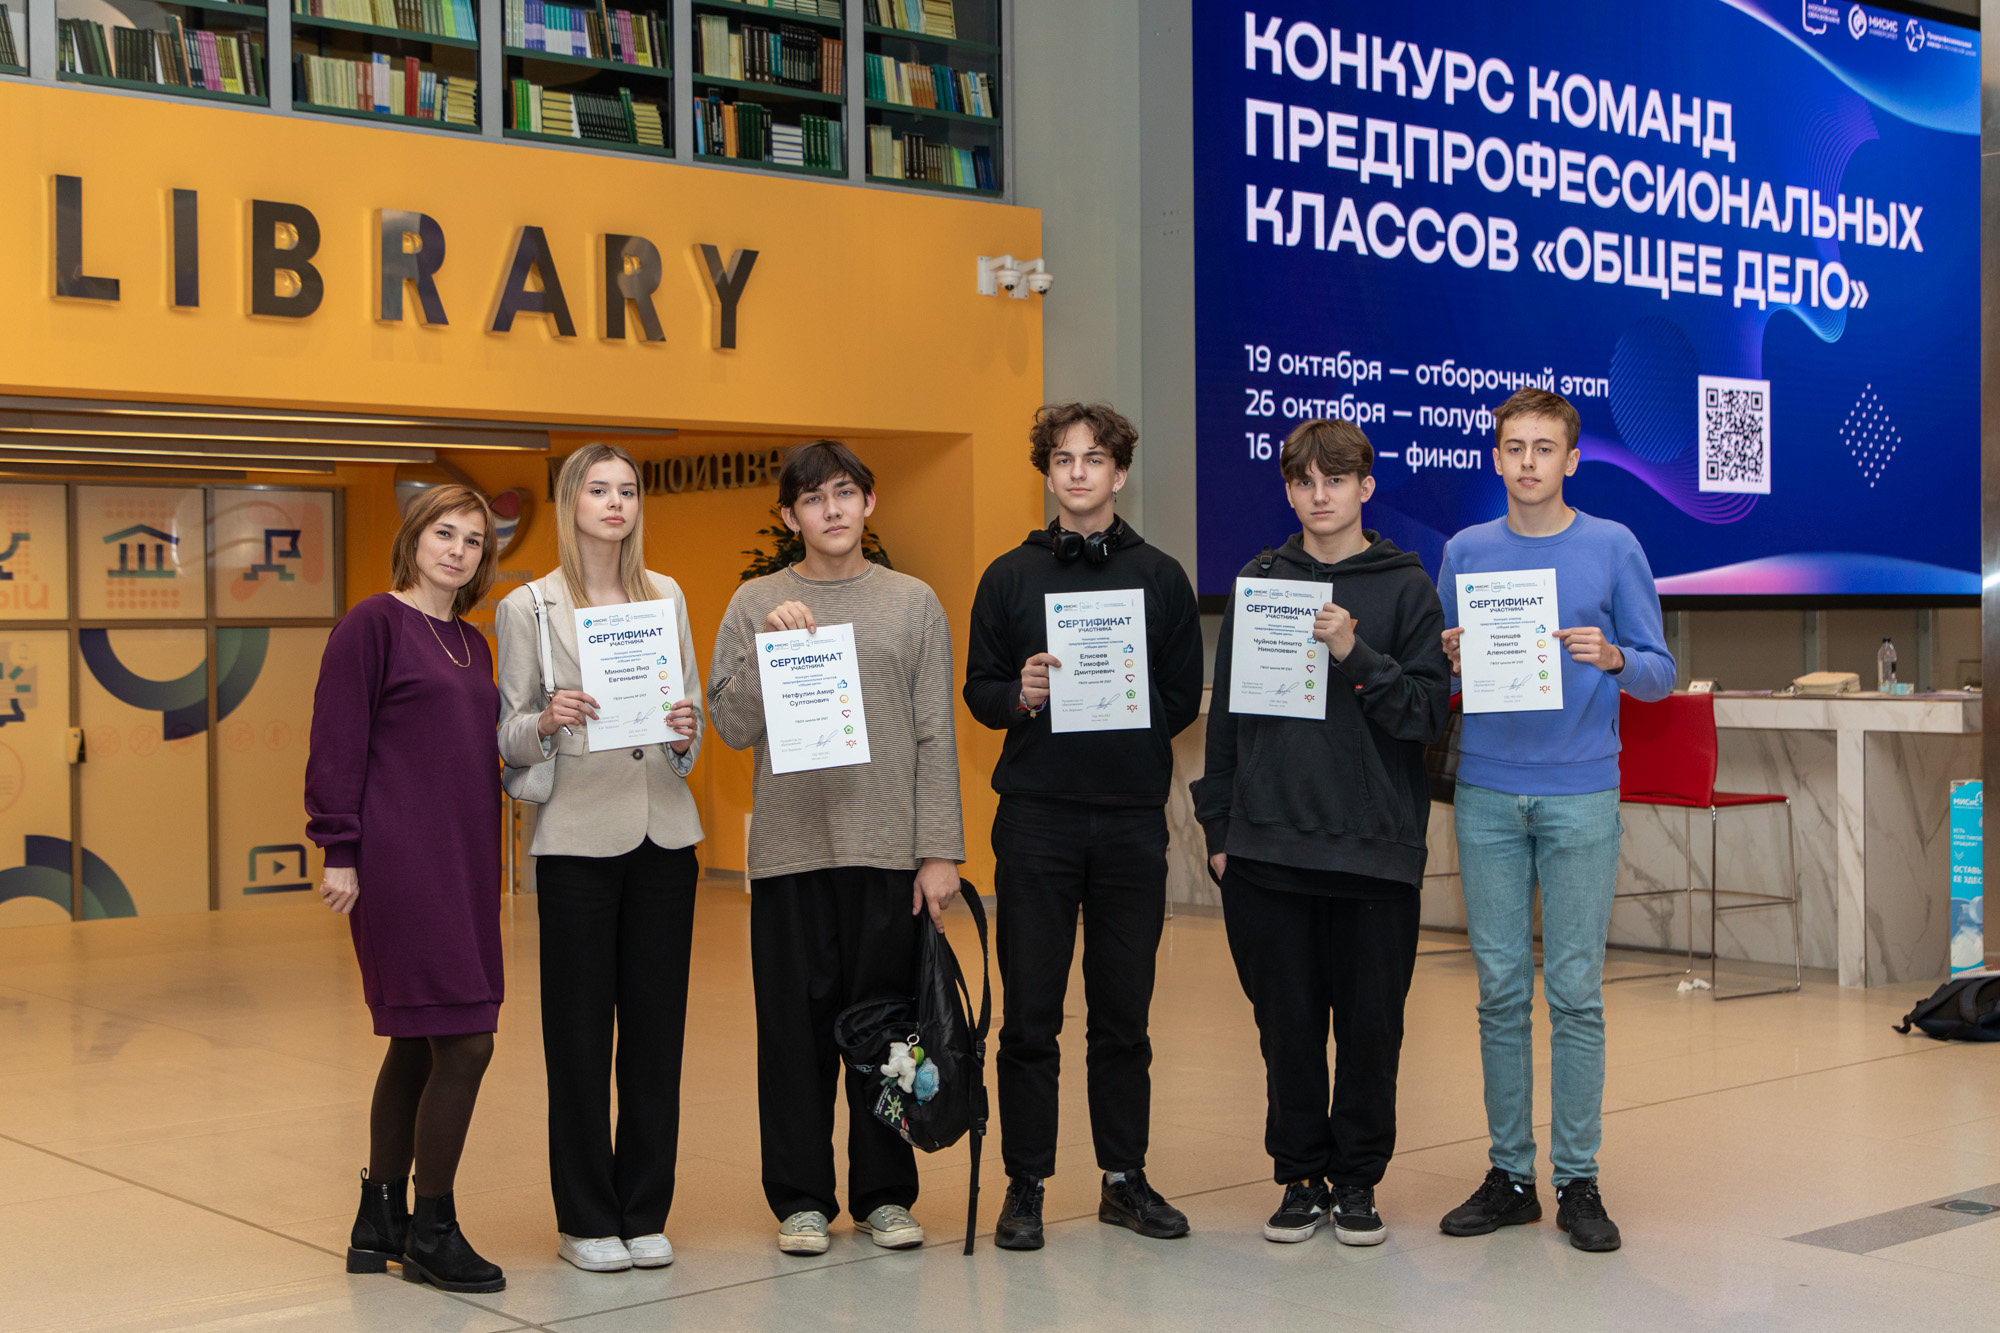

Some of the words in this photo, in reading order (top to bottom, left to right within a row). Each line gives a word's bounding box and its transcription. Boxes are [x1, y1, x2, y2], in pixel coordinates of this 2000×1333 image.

[1868, 15, 1899, 33] МИСИС
[1245, 11, 1515, 114] КОНКУРС
[1528, 65, 1736, 163] КОМАНД
[1245, 97, 1924, 253] ПРЕДПРОФЕССИОНАЛЬНЫХ
[1245, 184, 1519, 272] КЛАССОВ
[1531, 226, 1724, 300] «ОБЩЕЕ
[1733, 249, 1870, 311] ДЕЛО»
[50, 173, 760, 351] LIBRARY
[1244, 344, 1272, 372] 19
[1278, 350, 1382, 387] октября
[1415, 359, 1555, 396] отборочный
[1560, 374, 1609, 399] этап
[1245, 388, 1276, 417] 26
[1282, 393, 1386, 428] октября
[1419, 403, 1497, 436] полуф
[1245, 432, 1273, 460] 16
[1406, 440, 1482, 474] финал
[1470, 597, 1544, 608] СЕРТИФИКАТ
[1246, 604, 1318, 616] СЕРТИФИКАТ
[1058, 617, 1131, 628] СЕРТИФИКАТ
[589, 628, 663, 644] СЕРТИФИКАТ
[610, 639, 644, 647] УЧАСТНИКА
[770, 652, 843, 668] СЕРТИФИКАТ
[791, 663, 824, 671] УЧАСТНИКА
[609, 674, 647, 683] Евгеньевна
[816, 688, 834, 696] Амир
[790, 698, 829, 707] Султанович
[1953, 865, 1982, 875] ОСТАВЬ
[1953, 875, 1963, 884] ЕЕ
